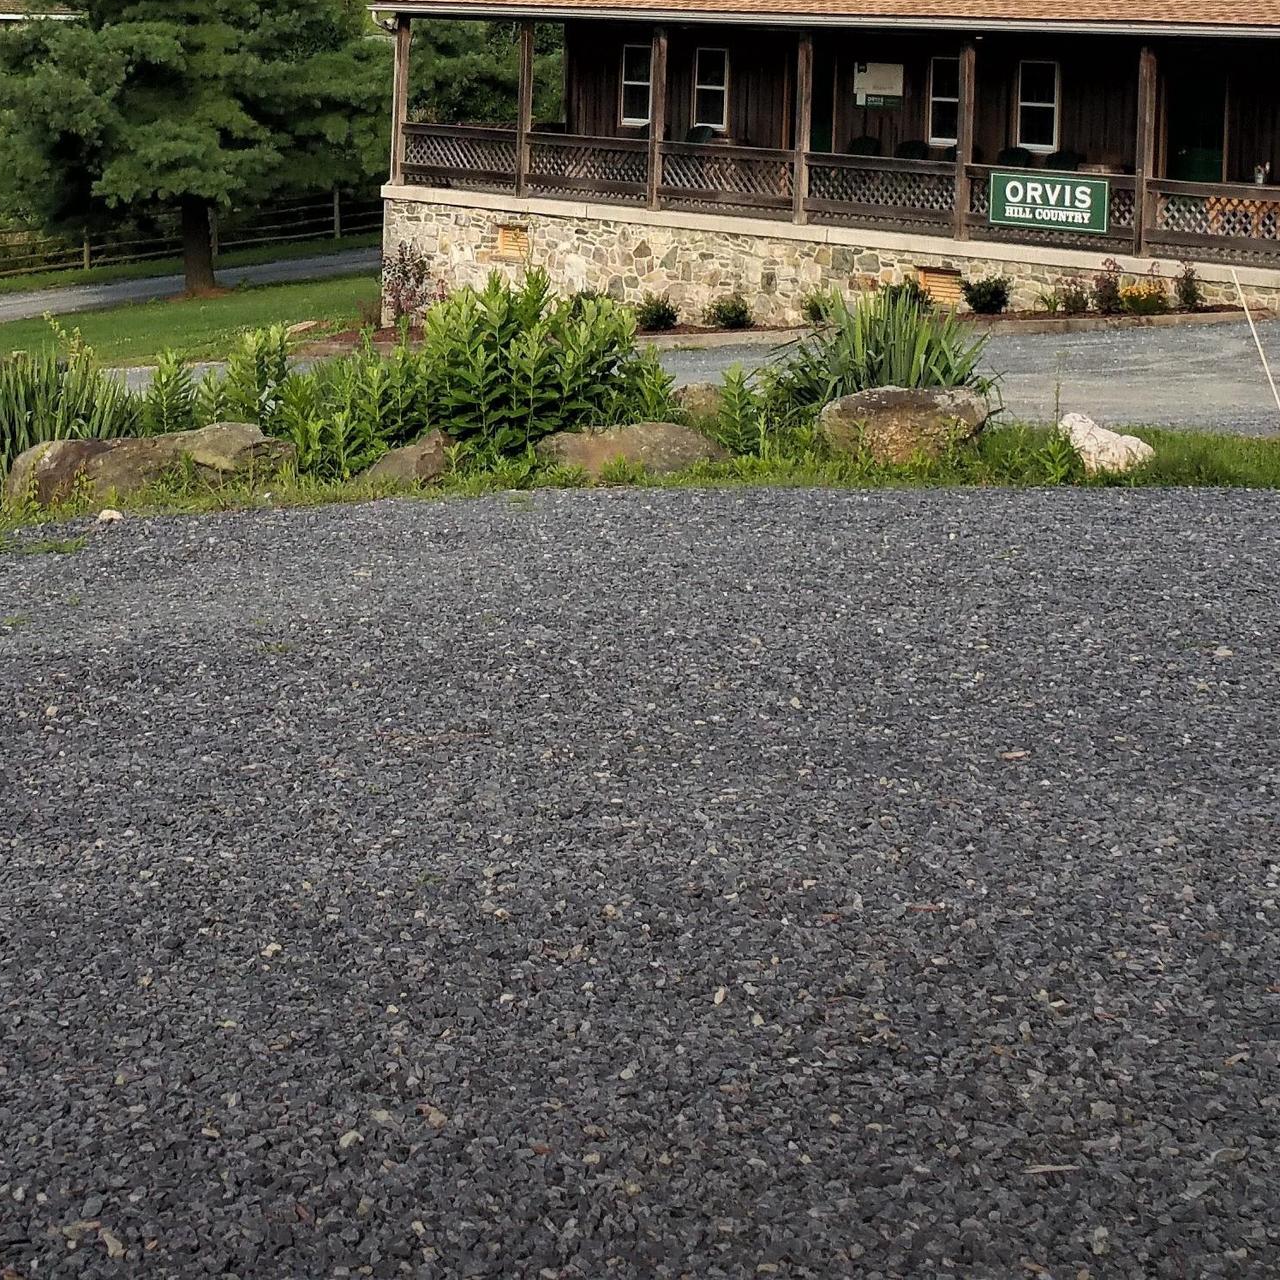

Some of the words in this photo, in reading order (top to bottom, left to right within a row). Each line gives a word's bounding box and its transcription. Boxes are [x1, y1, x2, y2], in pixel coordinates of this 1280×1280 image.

[1005, 180, 1092, 209] ORVIS
[1005, 206, 1033, 219] HILL
[1035, 209, 1091, 224] COUNTRY
